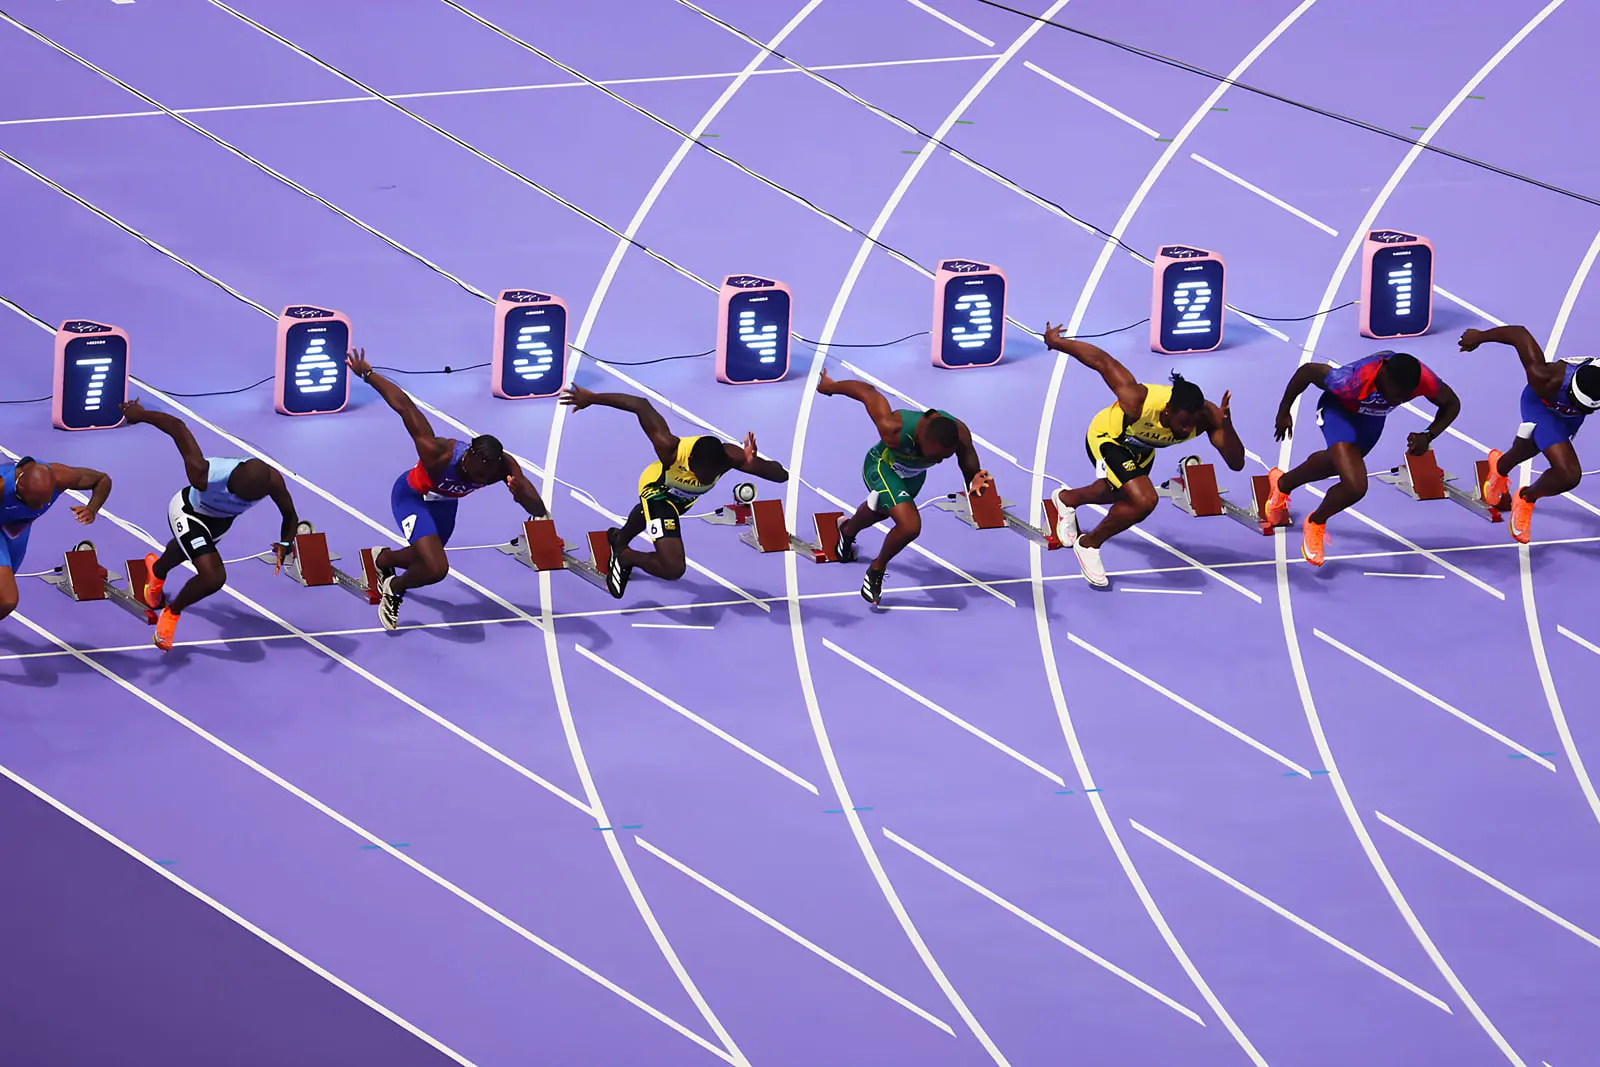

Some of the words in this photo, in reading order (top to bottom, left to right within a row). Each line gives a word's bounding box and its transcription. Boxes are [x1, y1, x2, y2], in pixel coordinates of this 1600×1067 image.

[1172, 281, 1212, 335] 2
[1387, 262, 1412, 316] 1
[738, 311, 778, 364] 4
[951, 293, 993, 349] 3
[295, 338, 339, 393] 6
[512, 325, 554, 381] 5
[75, 357, 113, 411] 7
[176, 521, 184, 533] 8
[650, 523, 658, 535] 6
